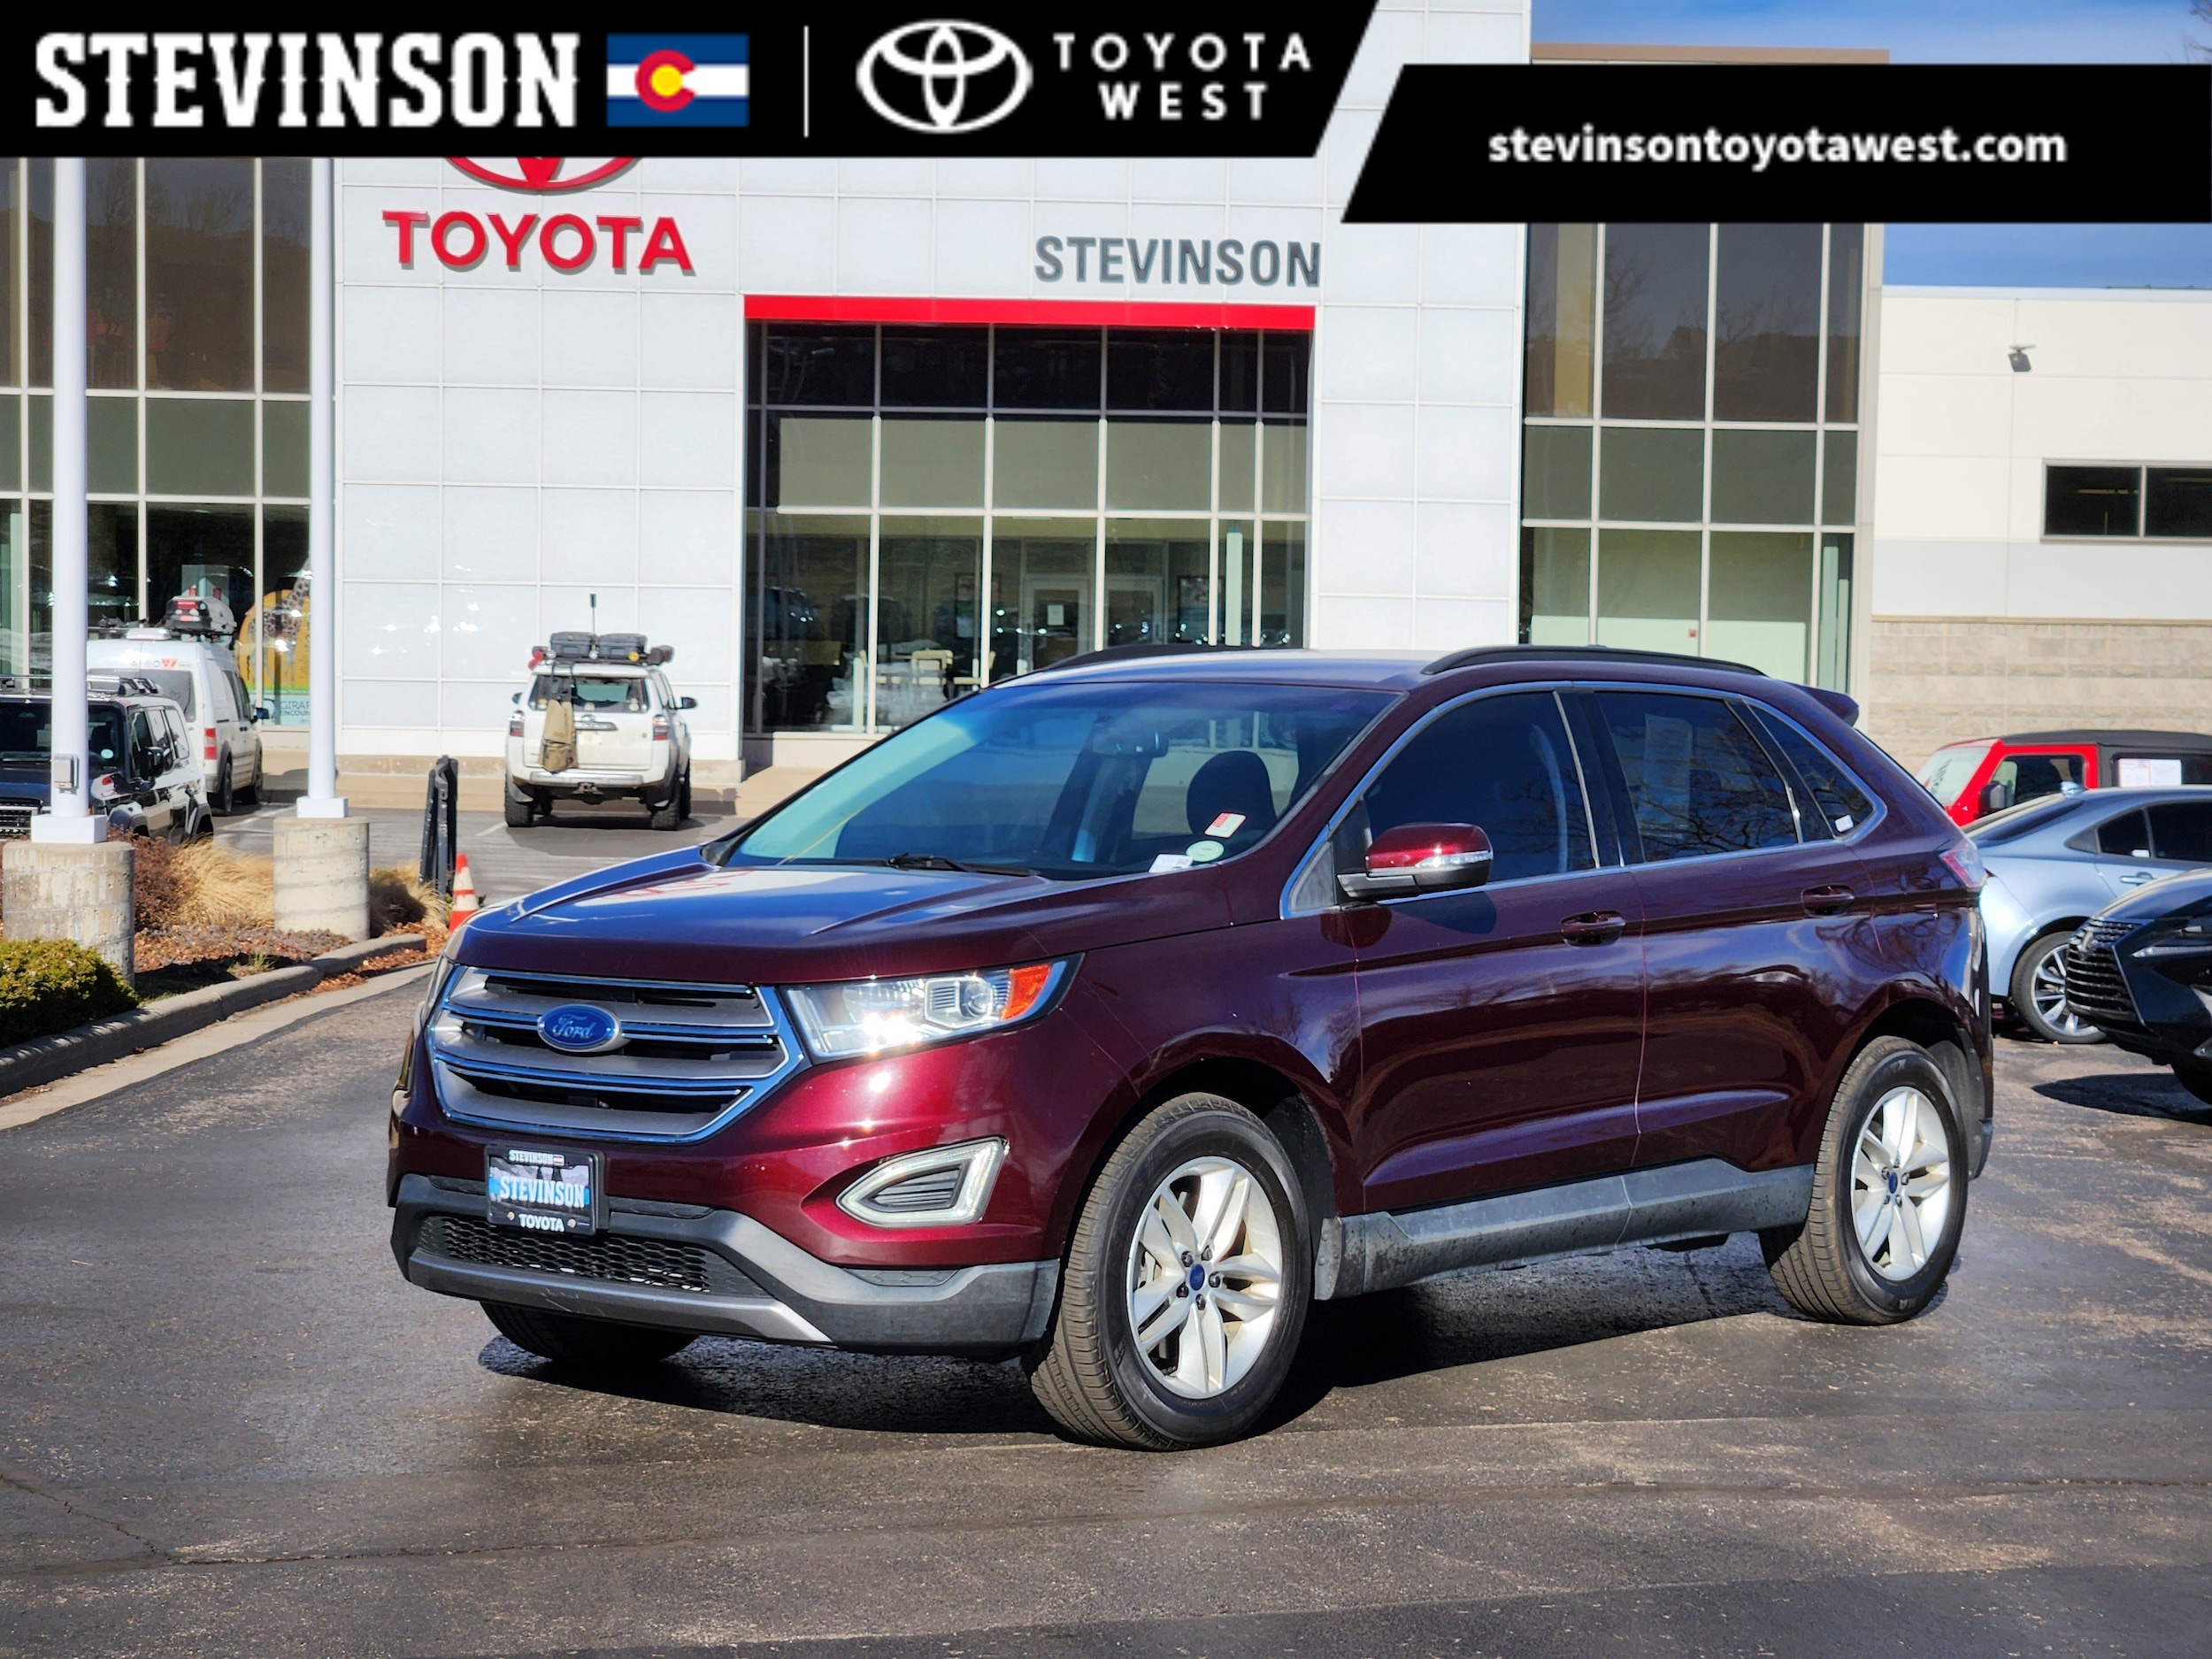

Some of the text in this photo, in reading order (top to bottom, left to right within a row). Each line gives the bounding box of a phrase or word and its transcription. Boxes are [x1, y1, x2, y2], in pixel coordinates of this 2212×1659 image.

[382, 210, 695, 274] TOYOTA
[1034, 235, 1320, 288] STEVINSON
[552, 1013, 596, 1039] Ford
[509, 1149, 554, 1165] STEVINSON
[499, 1175, 586, 1209] STEVINSON
[518, 1214, 565, 1232] TOYOTA
